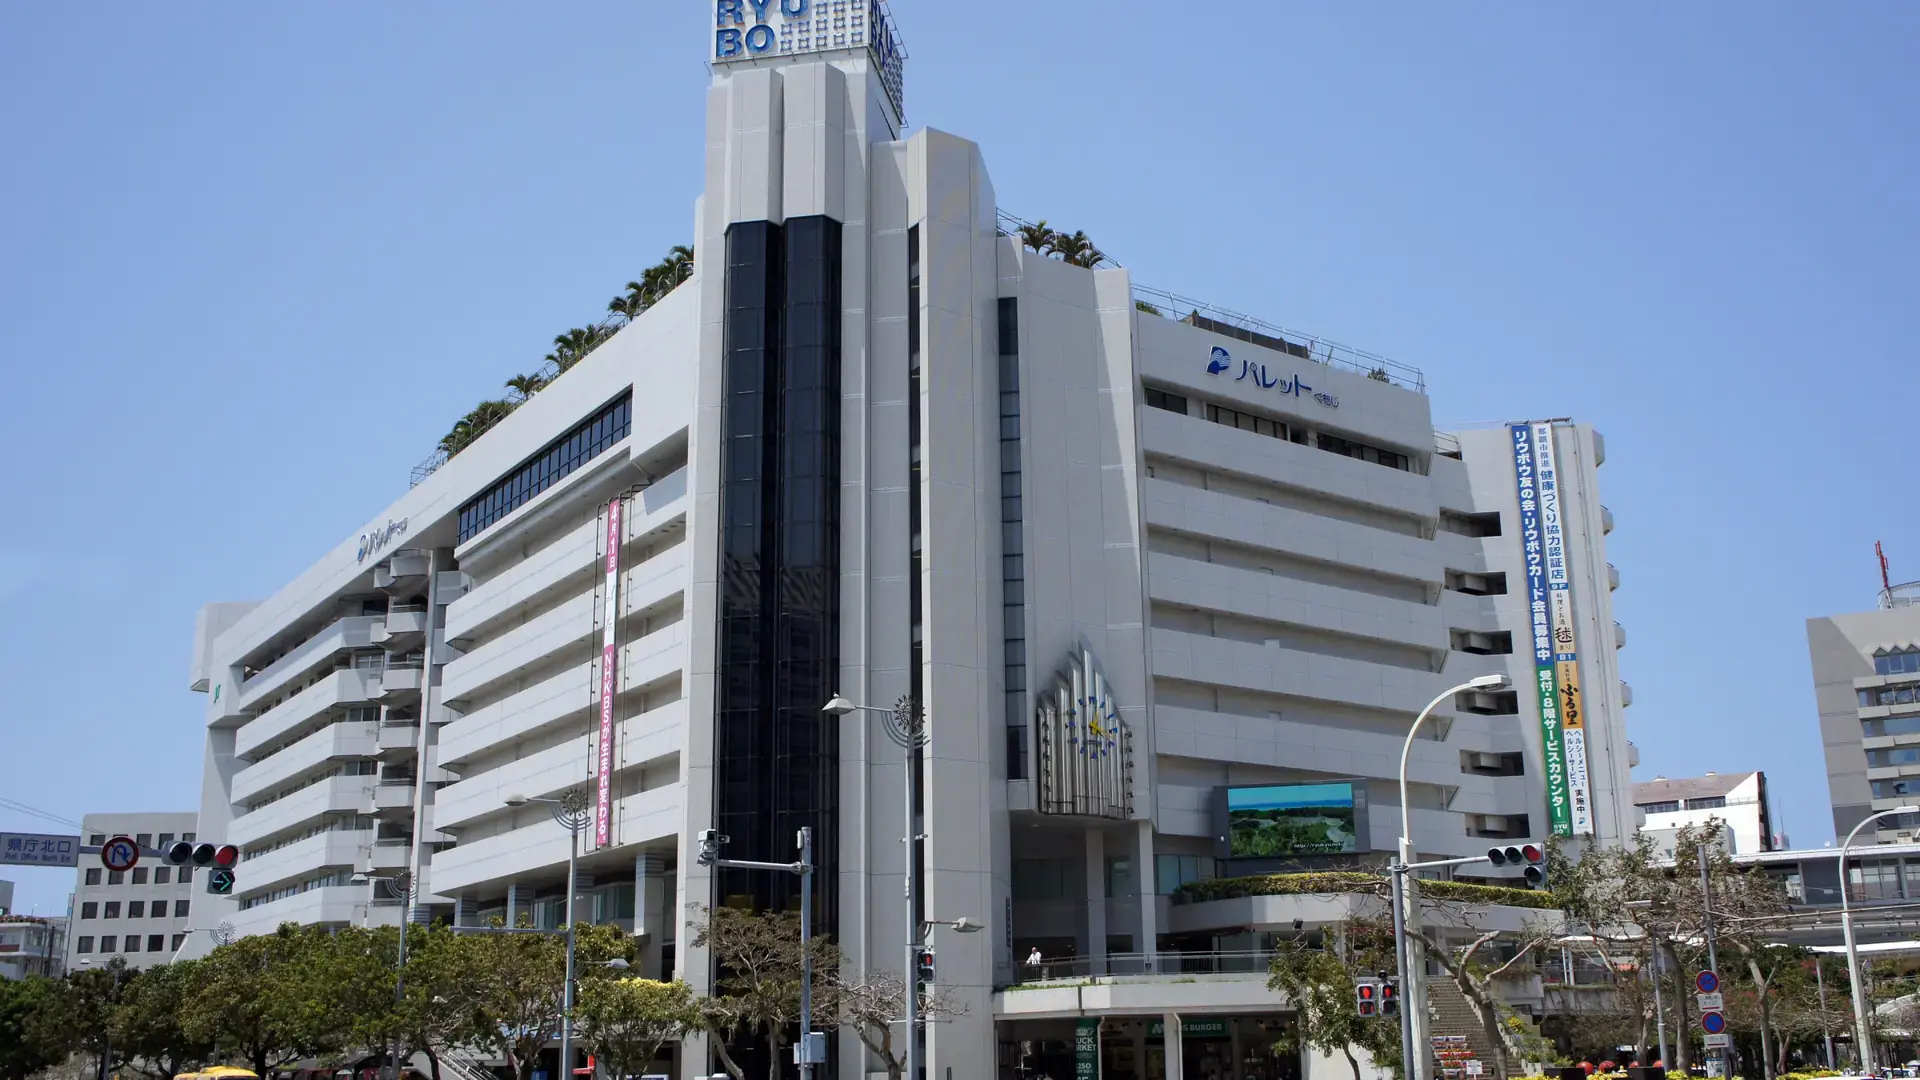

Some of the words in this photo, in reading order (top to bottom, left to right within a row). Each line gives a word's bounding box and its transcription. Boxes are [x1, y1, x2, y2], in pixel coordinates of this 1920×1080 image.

[717, 0, 809, 27] RYU
[716, 24, 776, 57] BO
[7, 838, 71, 853] 県庁北口
[1189, 1023, 1222, 1031] BURGER
